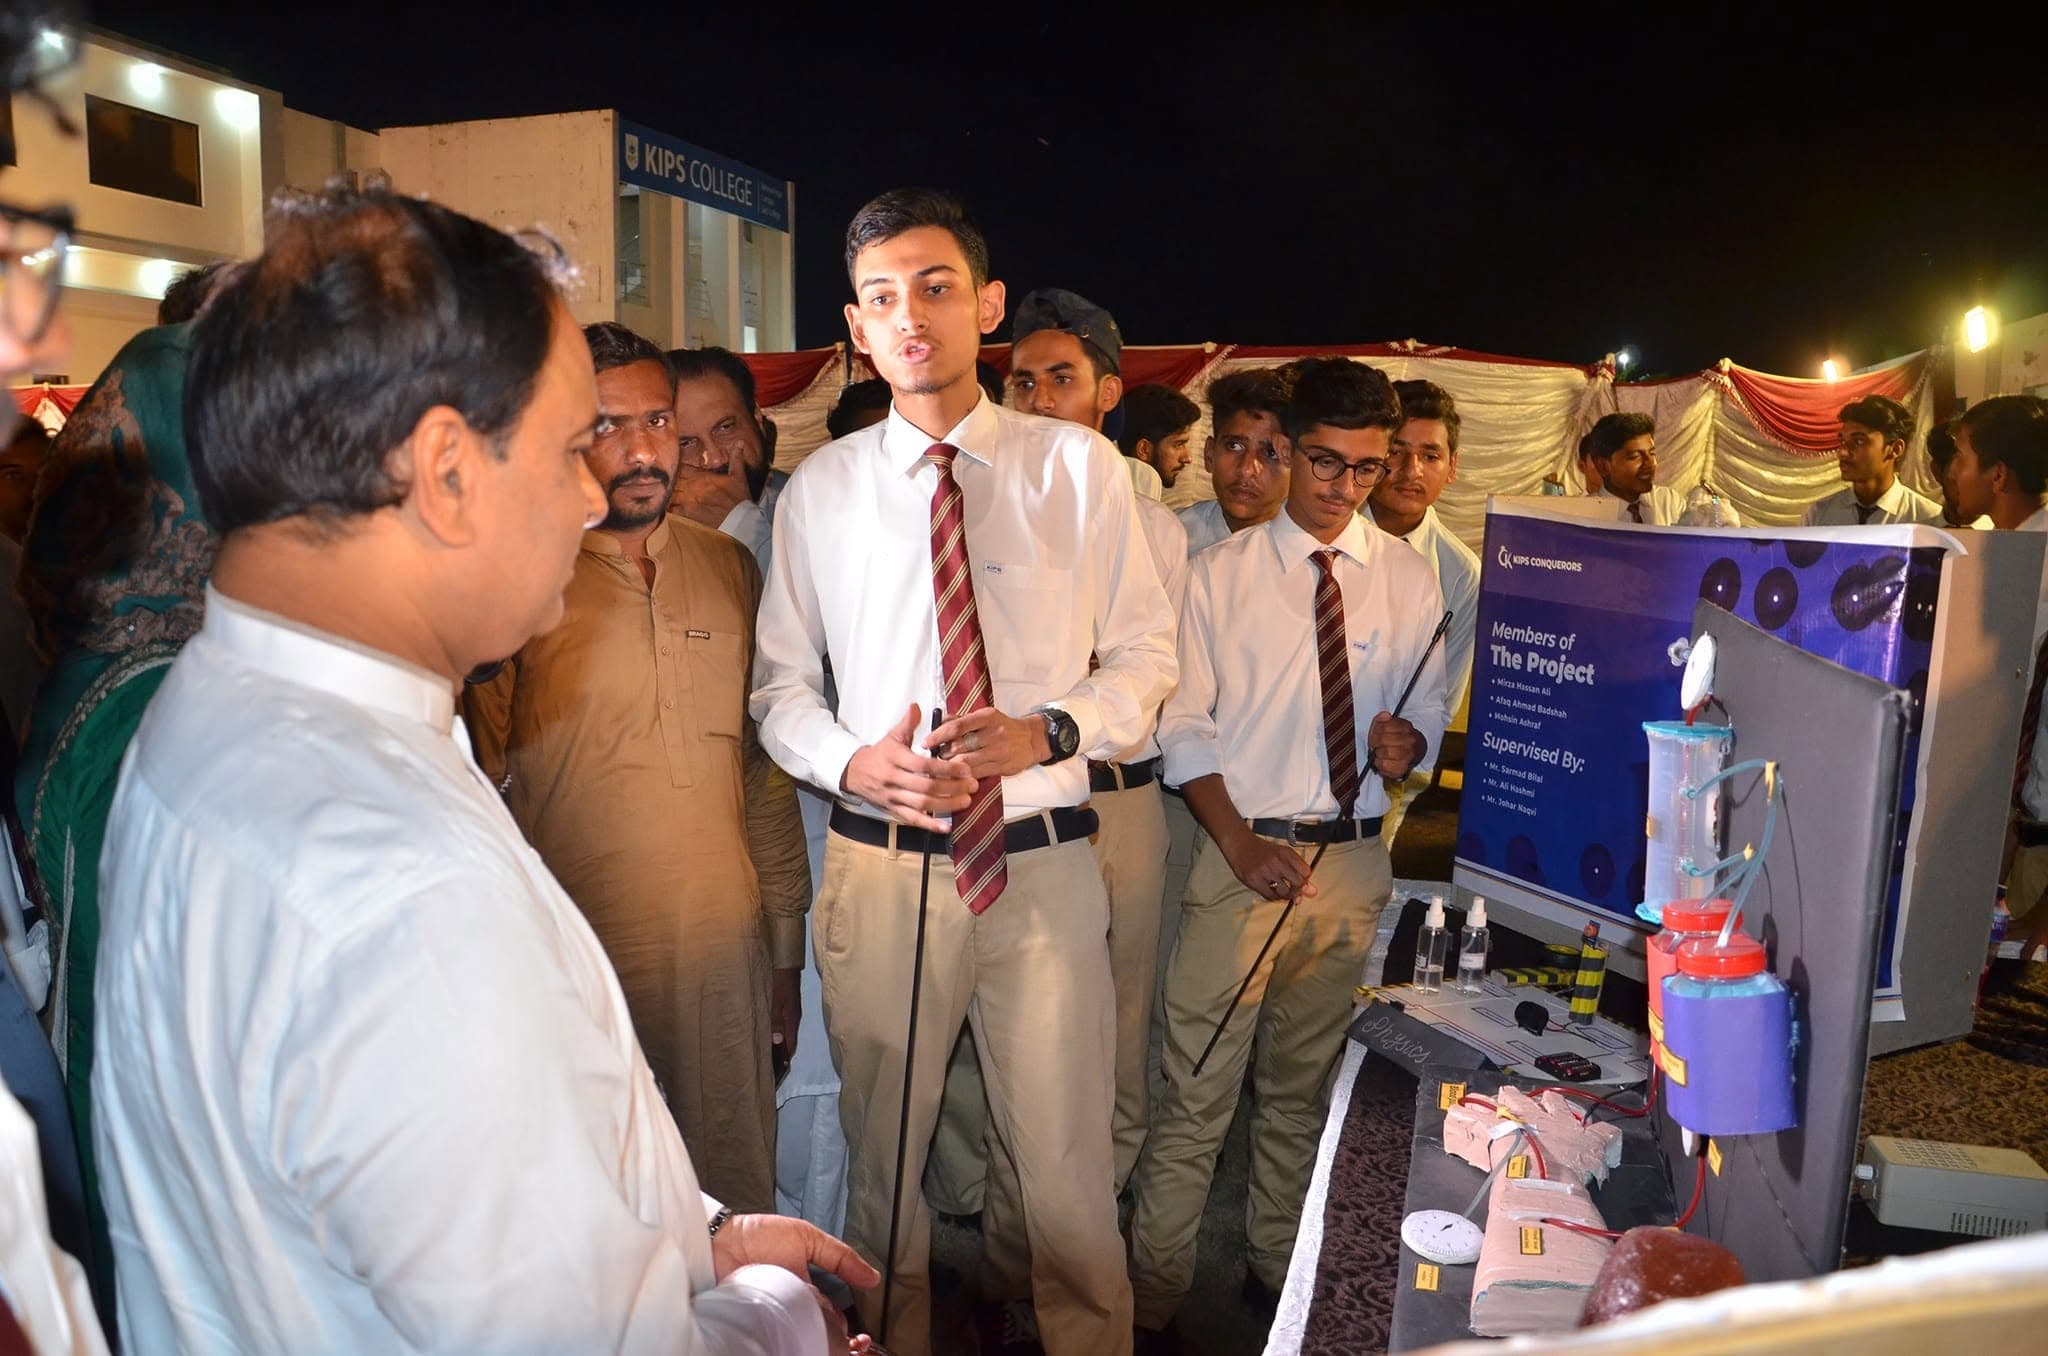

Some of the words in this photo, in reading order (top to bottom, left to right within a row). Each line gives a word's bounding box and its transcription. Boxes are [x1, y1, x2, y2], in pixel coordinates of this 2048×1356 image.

[645, 144, 686, 183] KIPS
[690, 160, 752, 206] COLLEGE
[1513, 554, 1529, 566] KIPS
[1530, 557, 1582, 572] CONQUERORS
[1492, 621, 1555, 648] Members
[1559, 633, 1576, 651] of
[1491, 645, 1523, 670] The
[1527, 652, 1595, 685] Project
[1497, 678, 1515, 689] Mirza
[1516, 681, 1540, 695] Hassan
[1542, 687, 1551, 697] Ali
[1495, 696, 1511, 707] Afaq
[1512, 699, 1536, 712] Ahmad
[1537, 704, 1567, 719] Badshah
[1494, 712, 1518, 725] Mohsin
[1519, 718, 1541, 730] Ashraf
[1482, 731, 1559, 765] Supervised
[1562, 750, 1586, 774] By:
[1489, 762, 1500, 772] Mr.
[1501, 765, 1527, 779] Sarmad
[1527, 772, 1543, 783] Bilal
[1500, 781, 1509, 791] Ali
[1362, 1016, 1432, 1064] Physics
